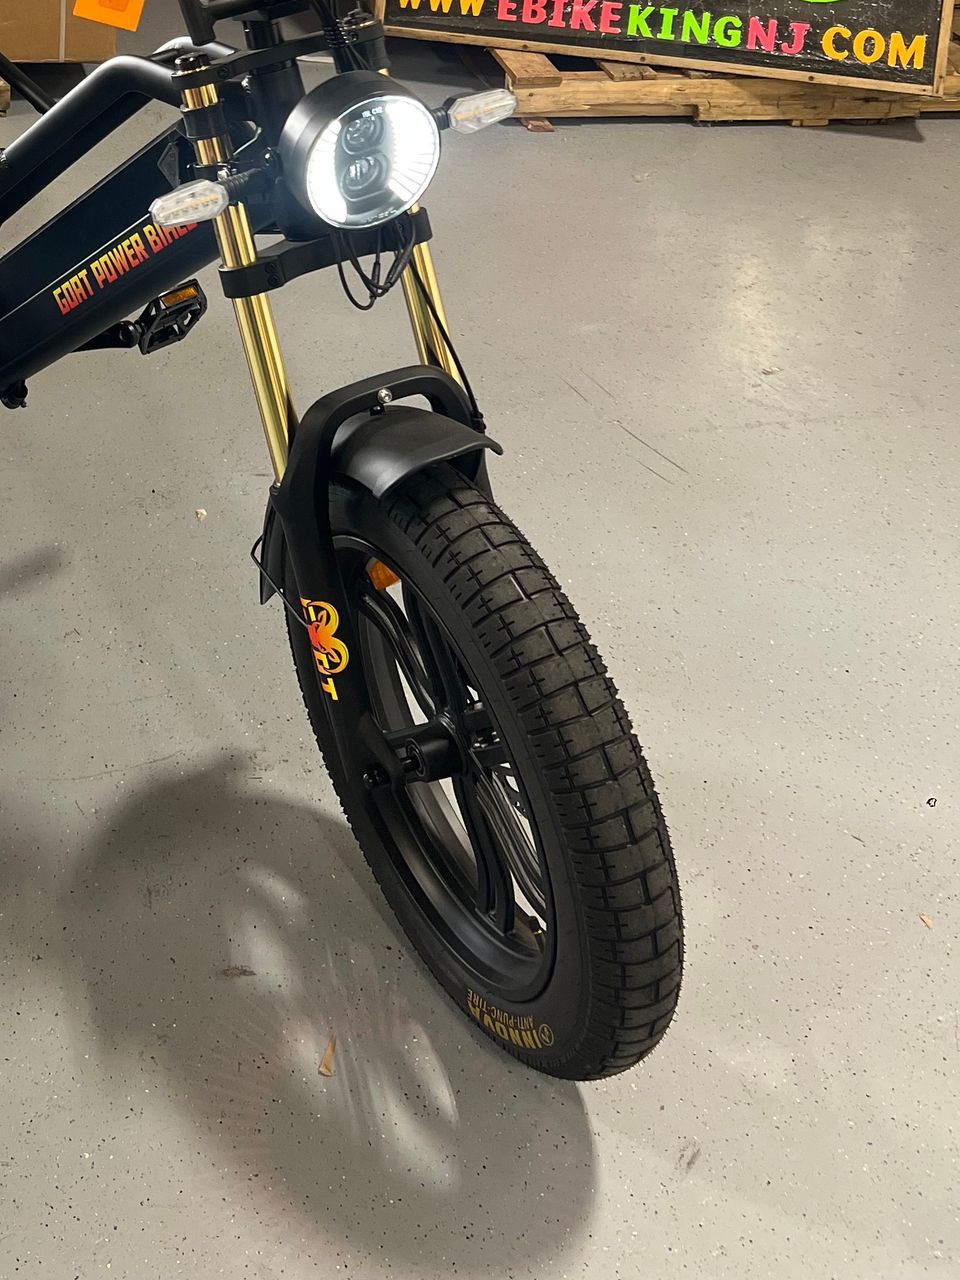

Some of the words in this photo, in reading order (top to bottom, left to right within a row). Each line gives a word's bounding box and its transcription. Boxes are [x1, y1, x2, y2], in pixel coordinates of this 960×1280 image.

[821, 25, 928, 71] COM
[52, 268, 95, 316] GOAT
[90, 232, 150, 289] POWER
[467, 989, 535, 1030] ANTI-PUNC-TIRE
[467, 1000, 543, 1050] INNOVA
